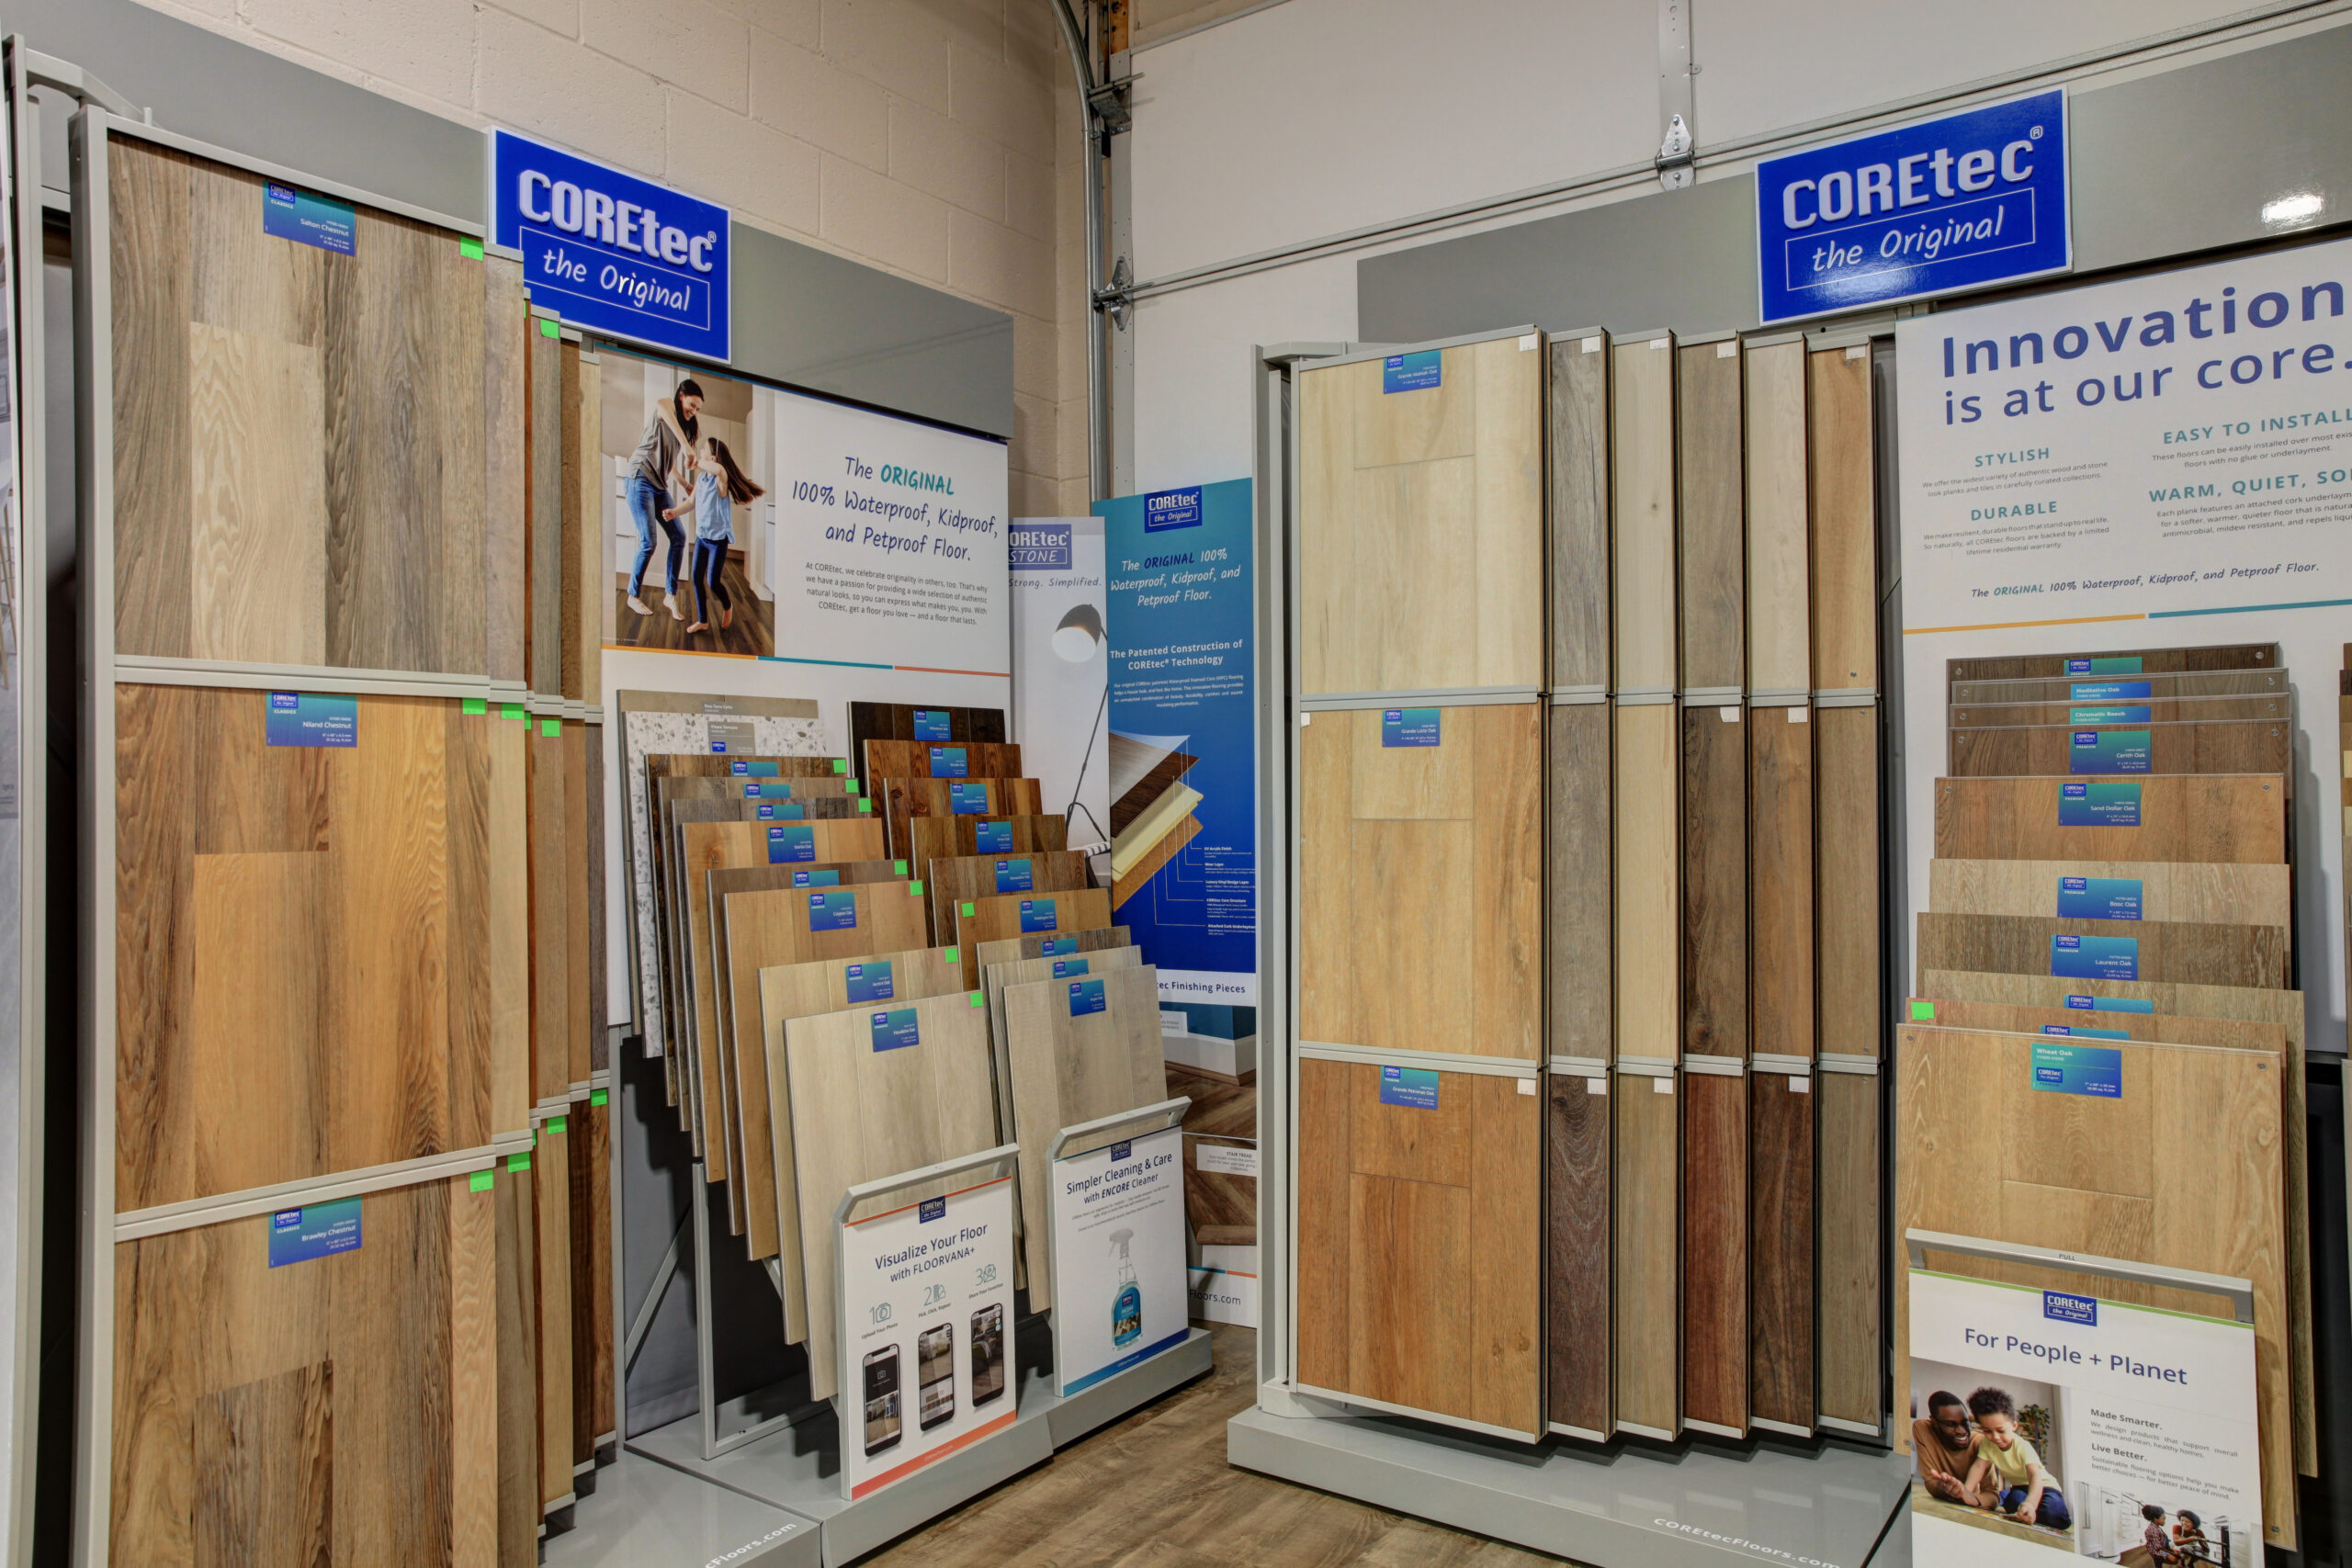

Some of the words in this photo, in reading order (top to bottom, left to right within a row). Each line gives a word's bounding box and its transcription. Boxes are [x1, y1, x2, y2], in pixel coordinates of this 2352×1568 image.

[300, 218, 321, 229] Salton
[322, 224, 349, 237] Chestnut
[1813, 241, 1863, 271] the
[1880, 205, 2004, 259] Original
[544, 248, 587, 282] the
[600, 265, 690, 311] Original
[1943, 280, 2345, 378] Innovation
[1946, 390, 1983, 425] is
[2003, 380, 2055, 417] at
[2076, 367, 2173, 406] our
[2197, 341, 2352, 390] core.
[2164, 427, 2213, 444] EASY
[2222, 423, 2250, 436] TO
[2261, 408, 2352, 432] INSTALL
[1975, 448, 2050, 468] STYLISH
[2152, 453, 2176, 462] These
[2177, 449, 2199, 459] floors
[2200, 448, 2215, 457] can
[2228, 443, 2252, 453] easily
[2254, 439, 2288, 449] installed
[2290, 436, 2310, 446] over
[2311, 433, 2335, 442] most
[2184, 458, 2208, 468] floors
[2208, 457, 2227, 466] with
[2227, 456, 2239, 464] no
[2239, 453, 2258, 464] glue
[2259, 452, 2270, 460] or
[845, 457, 873, 479] The
[880, 464, 955, 495] ORIGINAL
[2149, 484, 2222, 502] WARM,
[2233, 475, 2306, 495] QUIET,
[2317, 469, 2352, 484] SO
[792, 480, 835, 506] 100%
[844, 491, 931, 527] Waterproof,
[938, 507, 999, 538] Kidproof,
[1153, 513, 1166, 523] the
[1168, 510, 1192, 520] Original
[1971, 502, 2058, 521] DURABLE
[2156, 509, 2176, 518] Each
[2177, 507, 2199, 517] plank
[2199, 503, 2233, 513] features
[2246, 499, 2283, 509] attached
[2284, 496, 2303, 505] cork
[826, 524, 855, 543] and
[864, 526, 928, 555] Petproof
[933, 538, 970, 561] Floor.
[1009, 549, 1058, 562] STONE
[1122, 560, 1139, 571] The
[1144, 553, 1194, 569] ORIGINAL
[1201, 548, 1227, 562] 100%
[1009, 578, 1044, 589] Strong.
[1048, 577, 1102, 589] Simplified.
[1111, 575, 1167, 591] Waterproof,
[1171, 570, 1216, 584] Kidproof,
[1221, 566, 1241, 578] and
[1972, 588, 1989, 598] The
[1994, 583, 2044, 597] ORIGINAL
[2050, 581, 2076, 592] 100%
[2082, 575, 2144, 592] Waterproof,
[2149, 571, 2198, 587] Kidproof,
[2203, 569, 2224, 581] and
[2231, 564, 2282, 579] Petproof
[2286, 563, 2319, 574] Floor.
[1137, 591, 1181, 608] Petproof
[1184, 590, 1212, 602] Floor.
[1109, 649, 1126, 660] The
[1128, 646, 1169, 657] Patented
[1170, 642, 1230, 653] Construction
[1232, 639, 1244, 649] of
[1172, 655, 1223, 667] Technology
[323, 721, 352, 729] Chestnut
[1172, 982, 1213, 993] Finishing
[1216, 983, 1247, 994] Pieces
[2036, 1047, 2058, 1055] Wheat
[2059, 1048, 2074, 1057] Oak
[1067, 1176, 1102, 1194] Simpler
[1105, 1164, 1142, 1181] Cleaning
[1145, 1158, 1151, 1169] &
[1153, 1154, 1172, 1167] Care
[1084, 1192, 1100, 1204] with
[1102, 1181, 1130, 1198] ENCORE
[1132, 1174, 1158, 1188] Cleaner
[301, 1231, 328, 1242] Brawley
[328, 1225, 356, 1235] Chestnut
[875, 1244, 927, 1269] Visualize
[931, 1235, 956, 1251] Your
[960, 1224, 988, 1242] Floor
[890, 1268, 910, 1282] with
[913, 1247, 975, 1273] FLOORVANA+
[976, 1269, 983, 1286] 3
[923, 1287, 932, 1306] 2
[978, 1288, 988, 1296] Your
[1189, 1290, 1240, 1306] Floors.com
[2052, 1306, 2064, 1315] the
[2064, 1309, 2088, 1320] Original
[861, 1331, 876, 1340] Upload
[876, 1326, 887, 1336] Your
[886, 1321, 899, 1332] Photo
[1964, 1327, 1999, 1349] For
[2006, 1335, 2082, 1365] People
[2089, 1352, 2101, 1366] +
[2109, 1354, 2188, 1385] Planet
[2090, 1408, 2118, 1420] Made
[2120, 1415, 2163, 1430] Smarter.
[2091, 1443, 2111, 1453] Live
[2114, 1447, 2147, 1461] Better.
[1654, 1518, 1840, 1568] COREtecFloors.com
